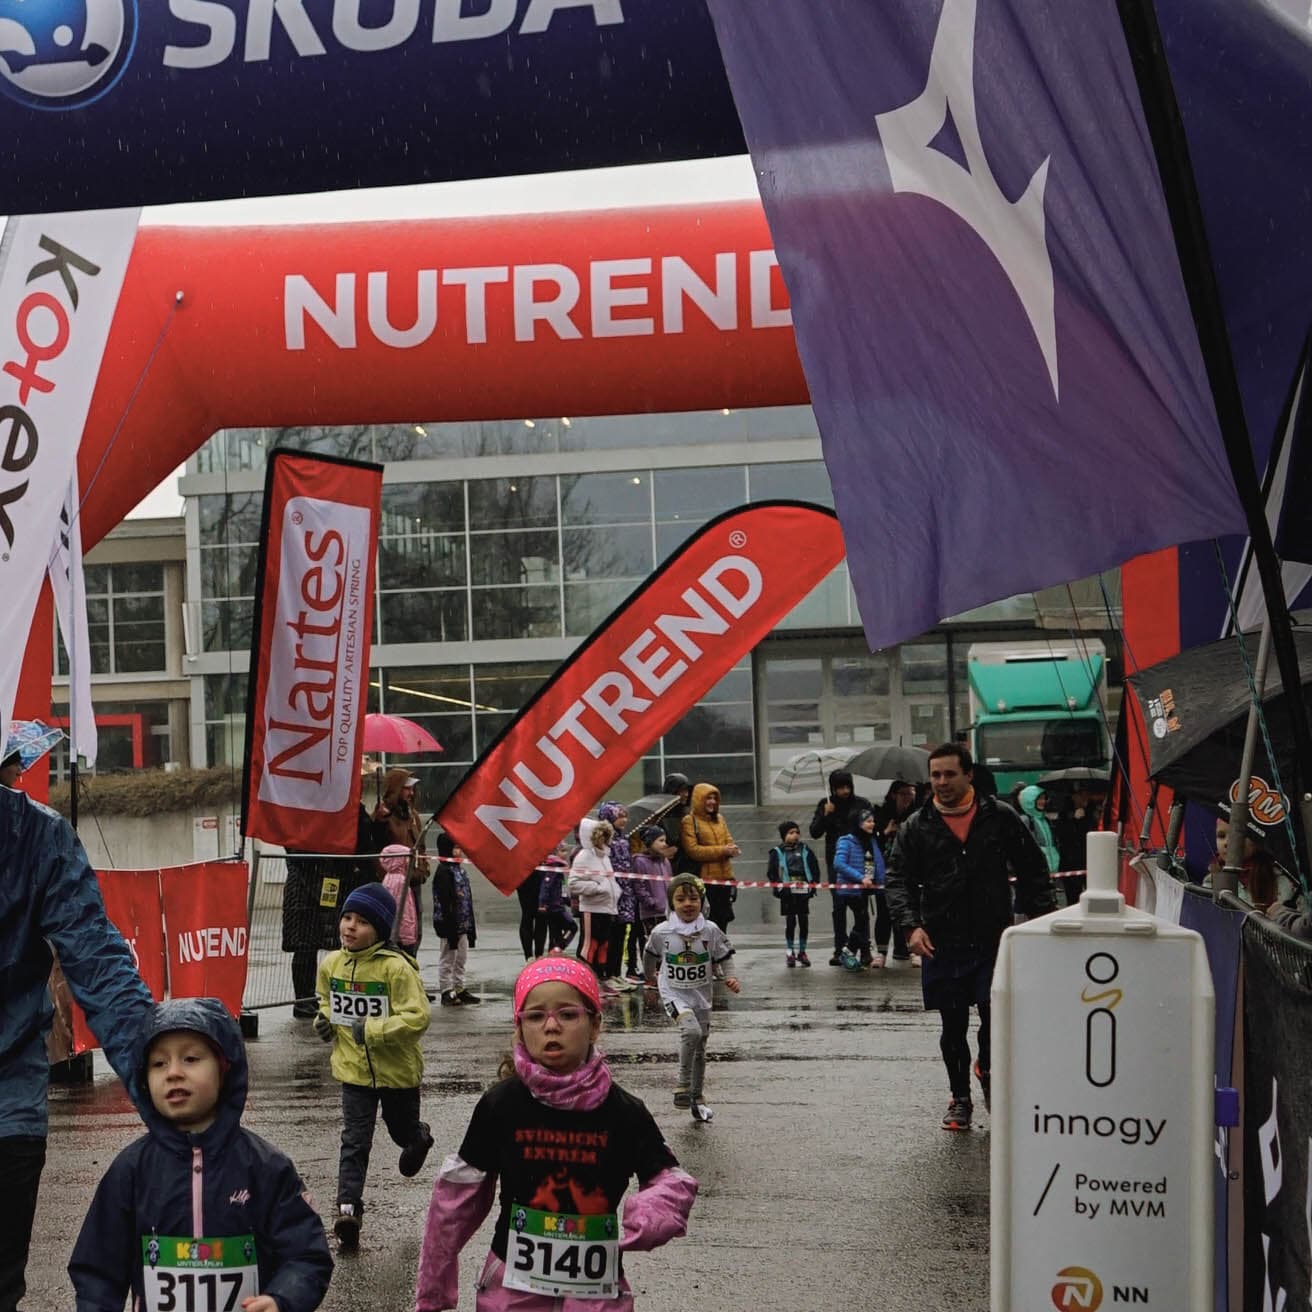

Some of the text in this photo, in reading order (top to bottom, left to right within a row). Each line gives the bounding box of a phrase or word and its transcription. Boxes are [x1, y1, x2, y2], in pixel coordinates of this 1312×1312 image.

[267, 528, 345, 786] Nartes
[336, 558, 361, 764] TOP QUALITY ARTESIAN SPRING
[474, 555, 763, 851] NUTREND
[667, 964, 706, 981] 3068
[332, 993, 382, 1018] 3203
[1034, 1104, 1167, 1145] innogy
[1075, 1173, 1167, 1194] Powered
[1075, 1196, 1165, 1219] by MVM
[514, 1235, 608, 1280] 3140
[156, 1272, 244, 1312] 3117
[1113, 1285, 1149, 1304] NN
